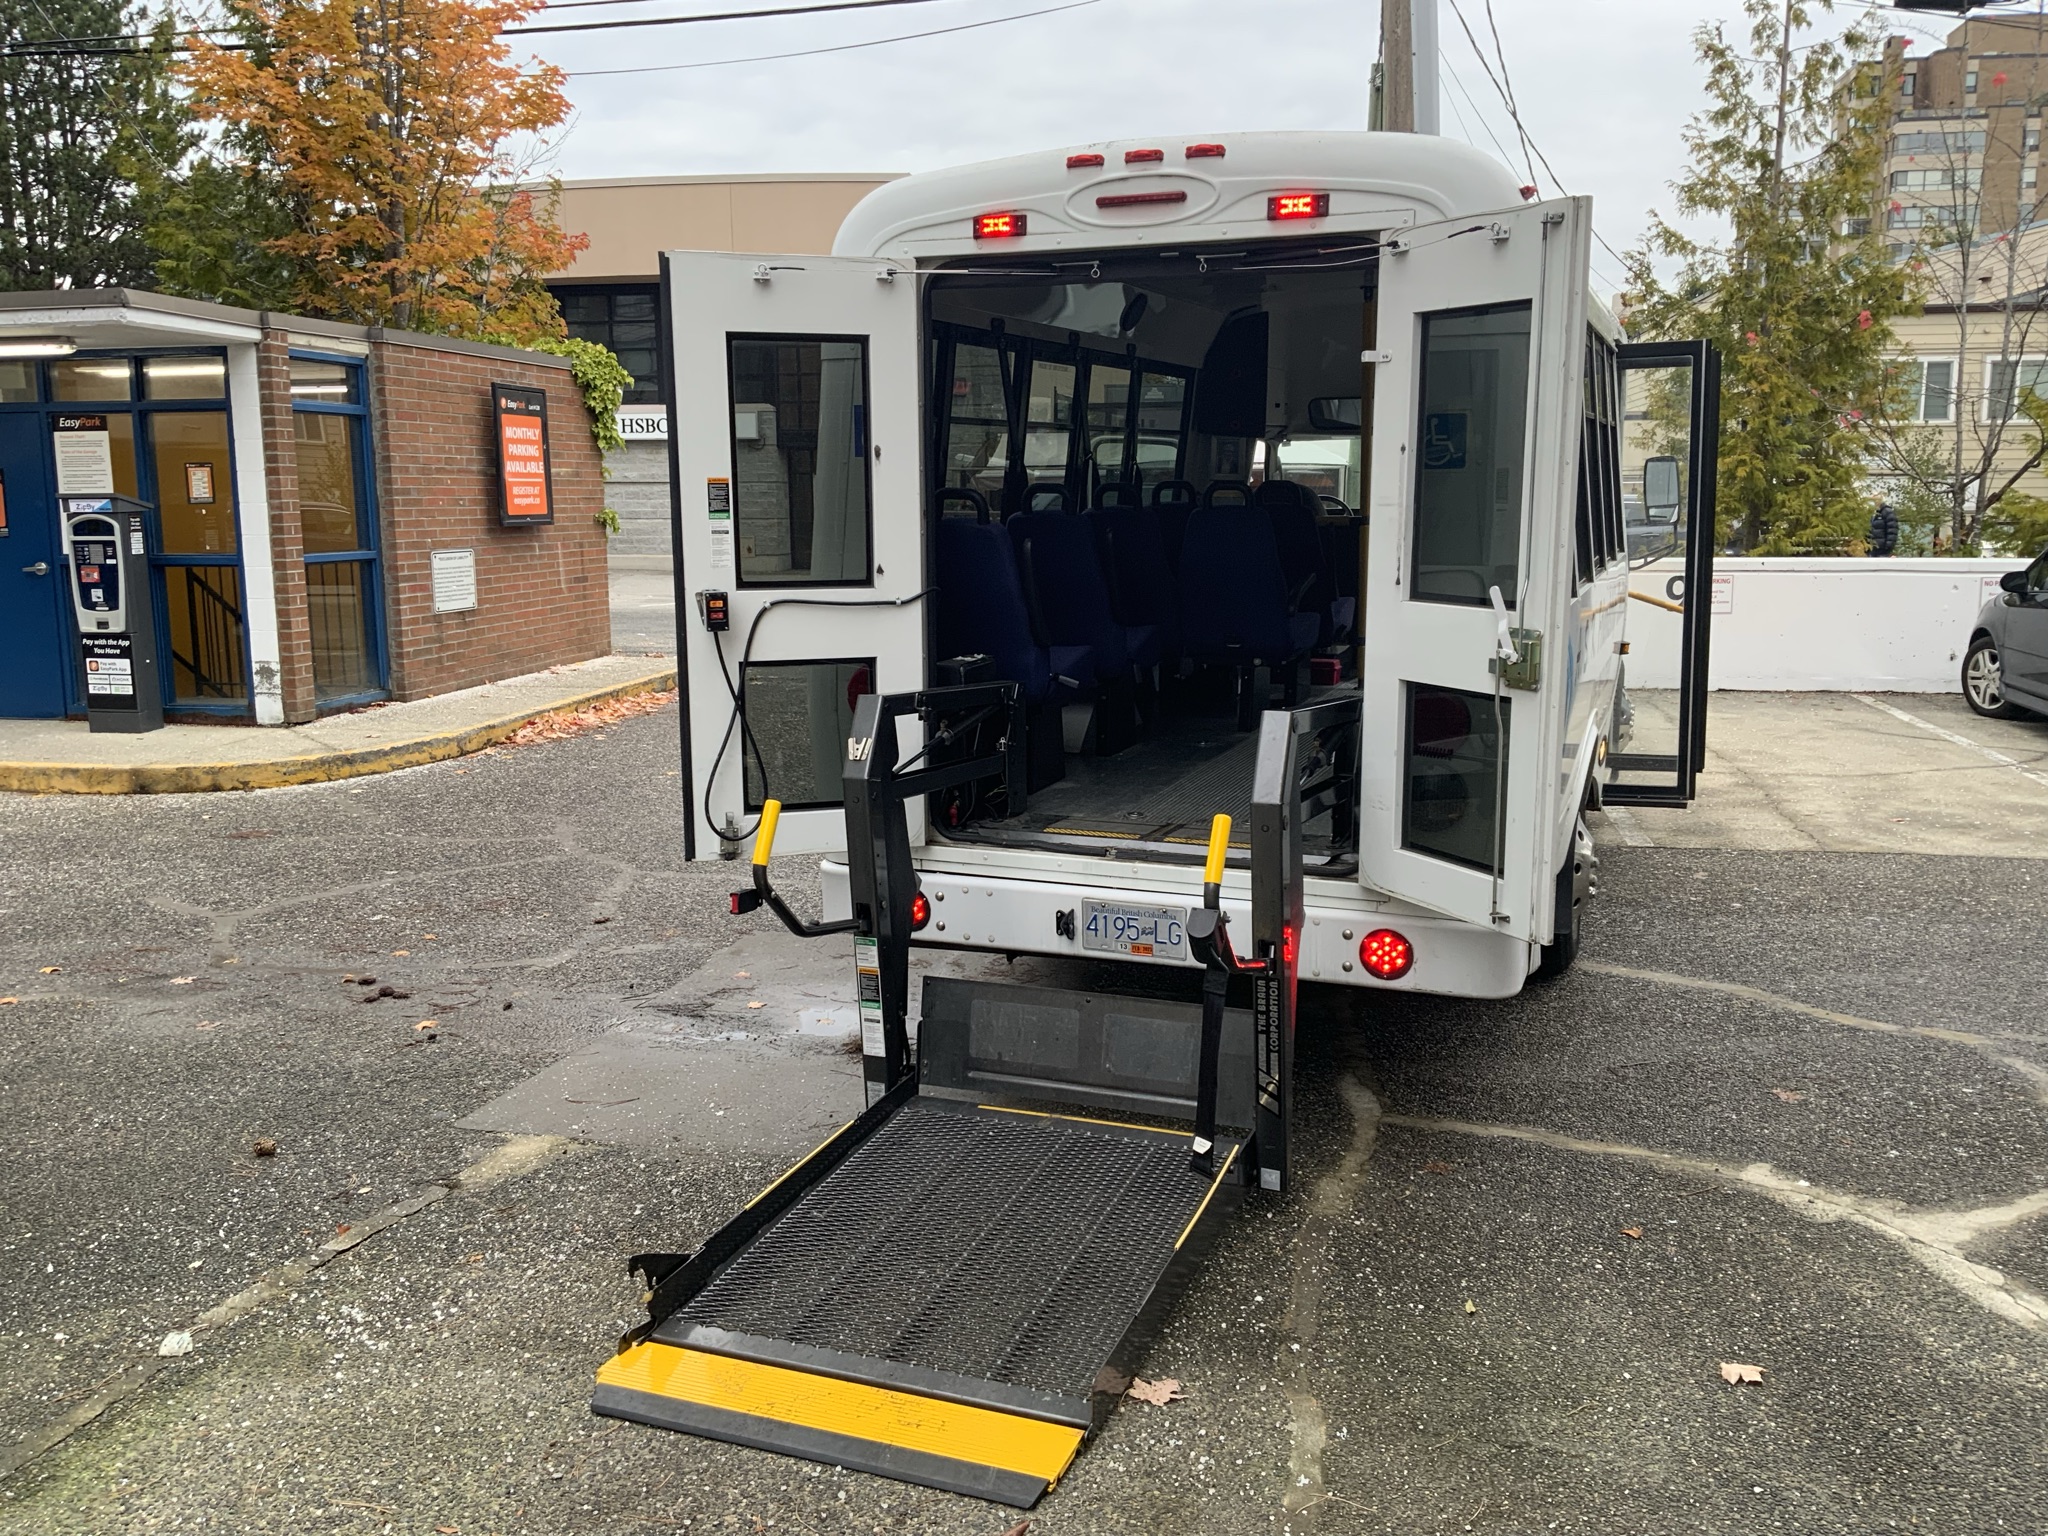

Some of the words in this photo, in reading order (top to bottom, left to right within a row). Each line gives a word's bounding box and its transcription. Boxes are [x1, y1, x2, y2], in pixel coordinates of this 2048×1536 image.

[507, 399, 526, 410] EasyPark
[59, 417, 101, 429] EasyPark
[621, 418, 668, 433] HSBC
[505, 426, 540, 440] MONTHLY
[508, 443, 539, 457] PARKING
[506, 461, 544, 474] AVAILABLE
[512, 486, 533, 495] REGISTER
[82, 638, 93, 646] Pay
[118, 639, 130, 647] App
[1091, 906, 1120, 916] Beautiful
[1121, 909, 1143, 918] British
[1143, 911, 1177, 921] Columbia
[1086, 914, 1140, 940] 4195
[1154, 919, 1182, 946] LG
[1258, 980, 1266, 1011] BRAUN
[1258, 1014, 1266, 1031] THE
